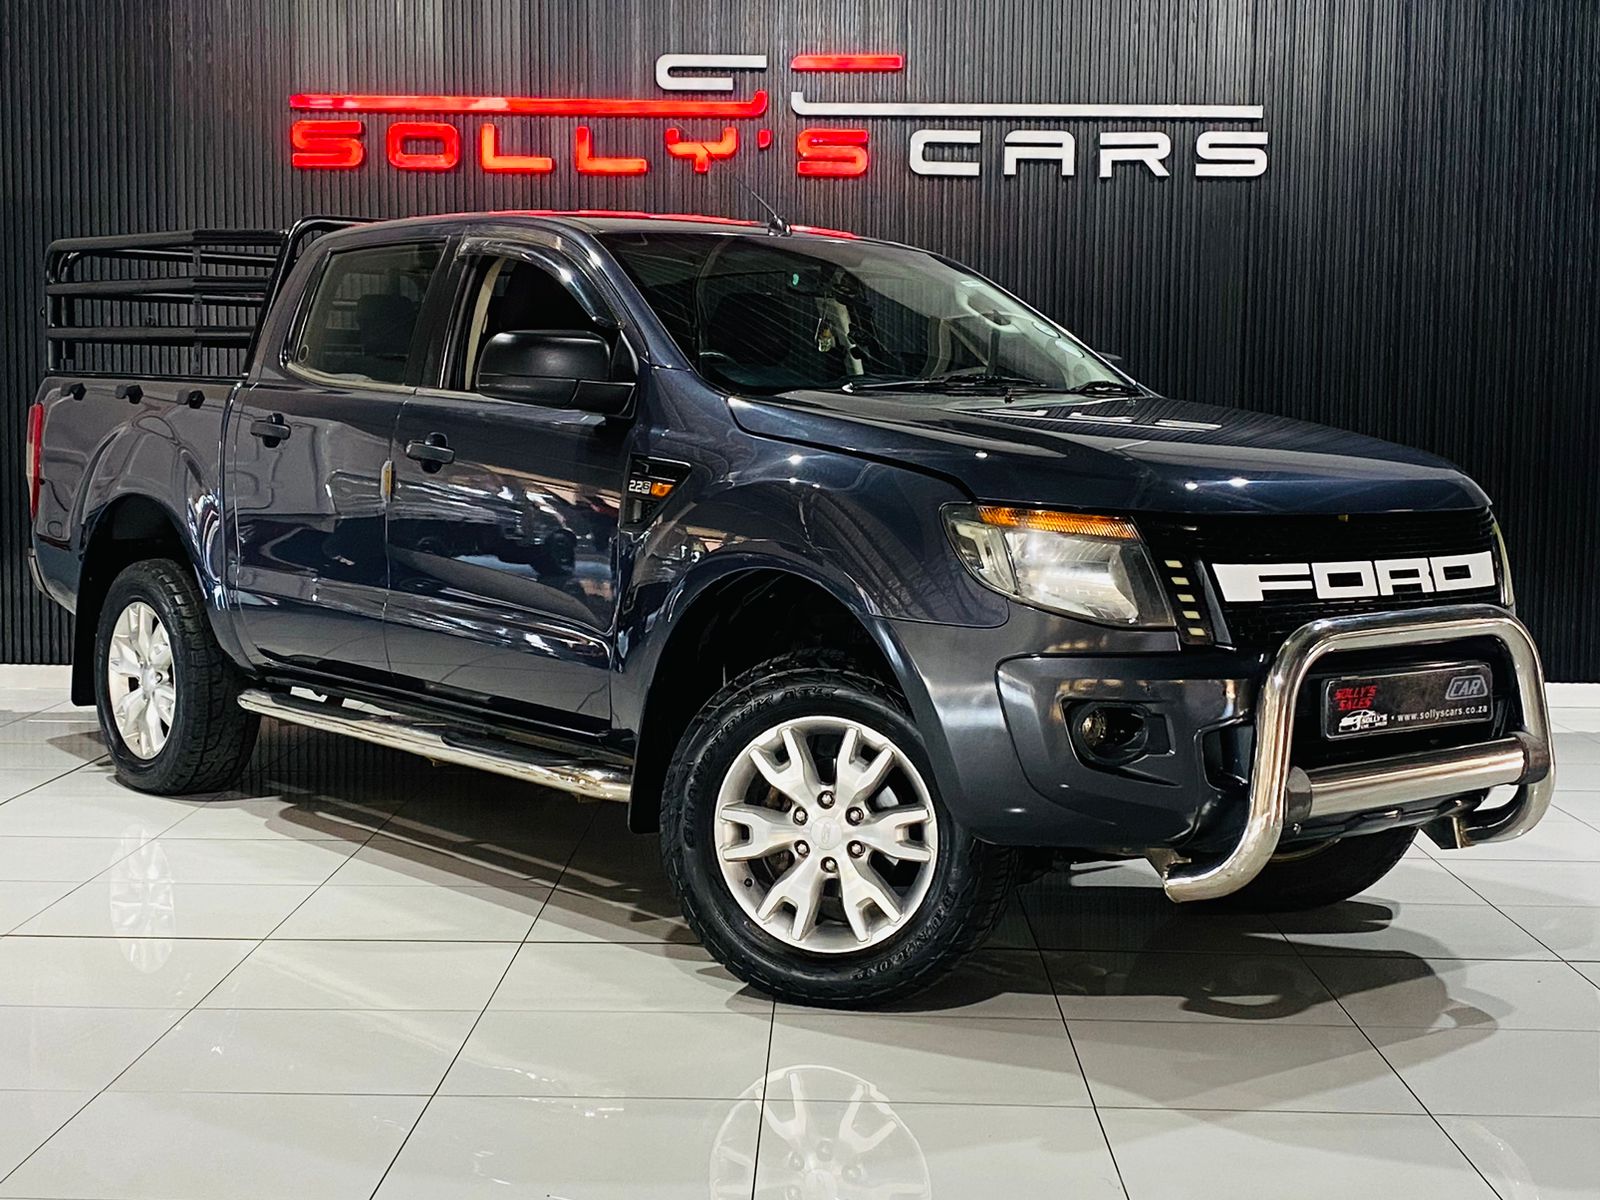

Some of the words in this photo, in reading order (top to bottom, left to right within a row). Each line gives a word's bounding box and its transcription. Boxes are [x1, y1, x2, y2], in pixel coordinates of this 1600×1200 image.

[290, 119, 871, 178] SOLLY'S
[909, 129, 1269, 178] CARS
[1211, 550, 1496, 602] FORD
[1397, 705, 1488, 721] www.sollyscars.co.za
